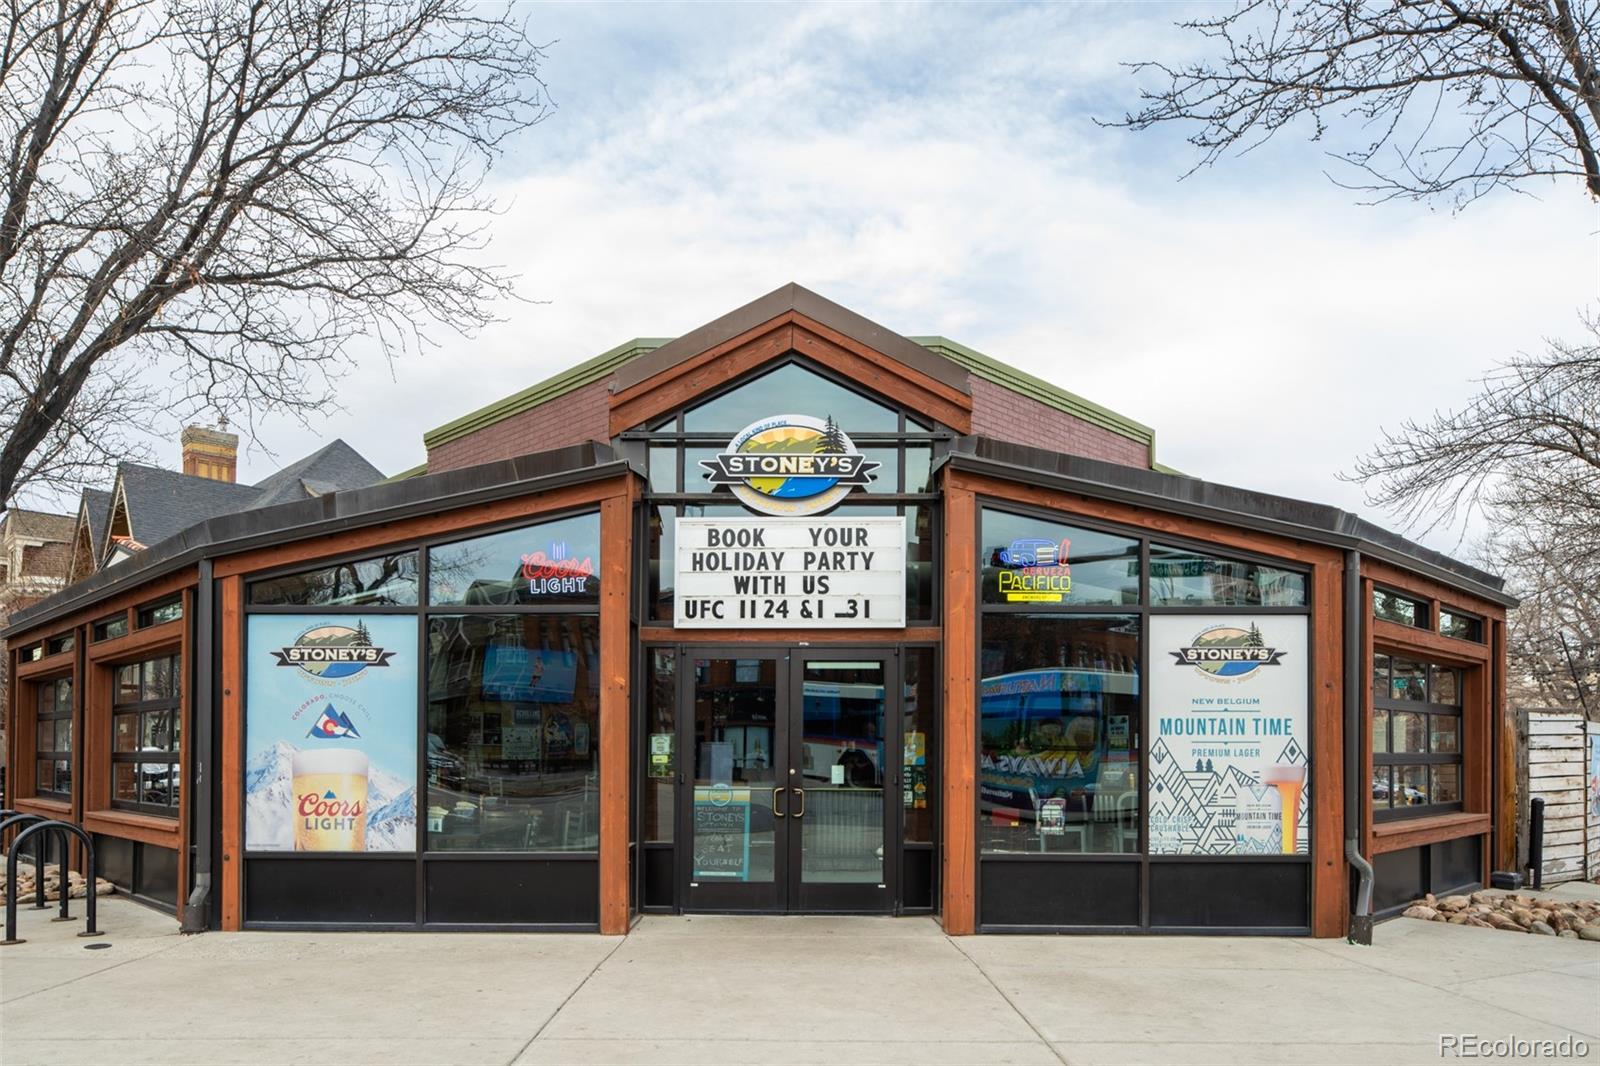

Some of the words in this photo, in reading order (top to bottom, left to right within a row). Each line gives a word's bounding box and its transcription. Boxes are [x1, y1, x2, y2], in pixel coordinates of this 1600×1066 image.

[729, 456, 853, 474] STONEY'S
[707, 528, 765, 547] BOOK
[808, 528, 868, 546] YOUR
[521, 551, 593, 578] Coors
[692, 552, 784, 571] HOLIDAY
[803, 552, 874, 570] PARTY
[1024, 568, 1070, 576] CERVEZA
[530, 577, 587, 594] LIGHT
[734, 576, 786, 595] WITH
[802, 576, 830, 594] US
[684, 600, 724, 619] UFC
[289, 648, 376, 660] STONEY'S
[1187, 649, 1268, 660] STONEY'S
[1160, 718, 1248, 736] MOUNTAIN
[1252, 718, 1292, 736] TIME
[1192, 748, 1230, 757] PREMIUM
[1234, 748, 1260, 758] LAGER
[298, 792, 362, 817] Coors
[305, 818, 355, 830] LIGHT
[1268, 812, 1282, 820] TIME
